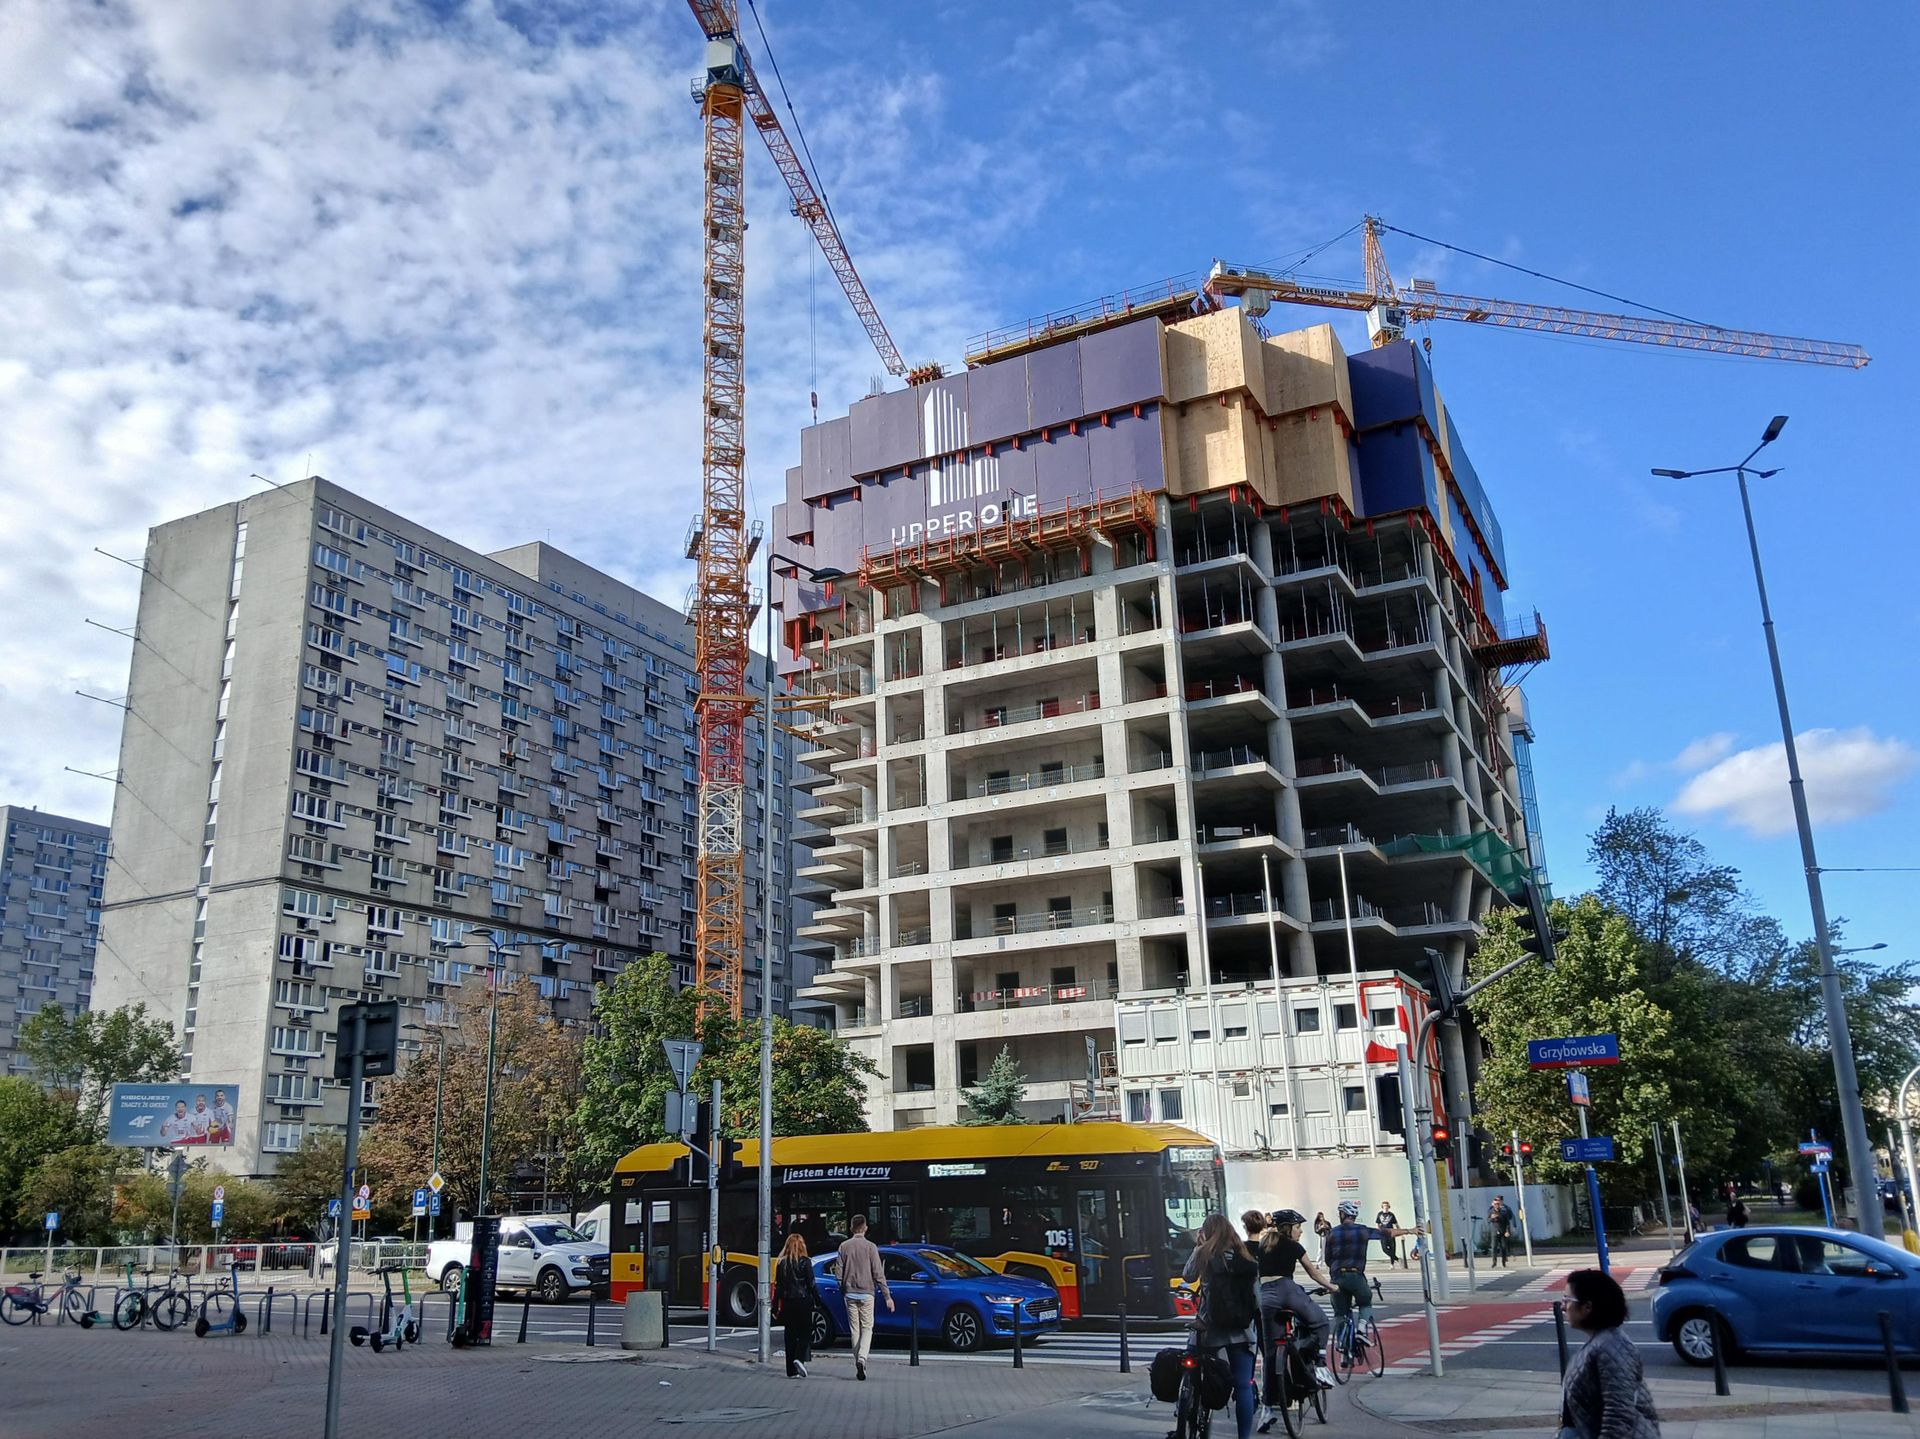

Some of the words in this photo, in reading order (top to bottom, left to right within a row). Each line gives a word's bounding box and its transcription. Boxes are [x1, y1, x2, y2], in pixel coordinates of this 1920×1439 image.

[891, 509, 973, 546] UPPER
[1538, 1042, 1607, 1060] Grzybowska
[128, 1115, 154, 1128] 4F
[788, 1168, 824, 1180] jestem
[827, 1166, 891, 1178] elektryczny
[1045, 1230, 1067, 1247] 106
